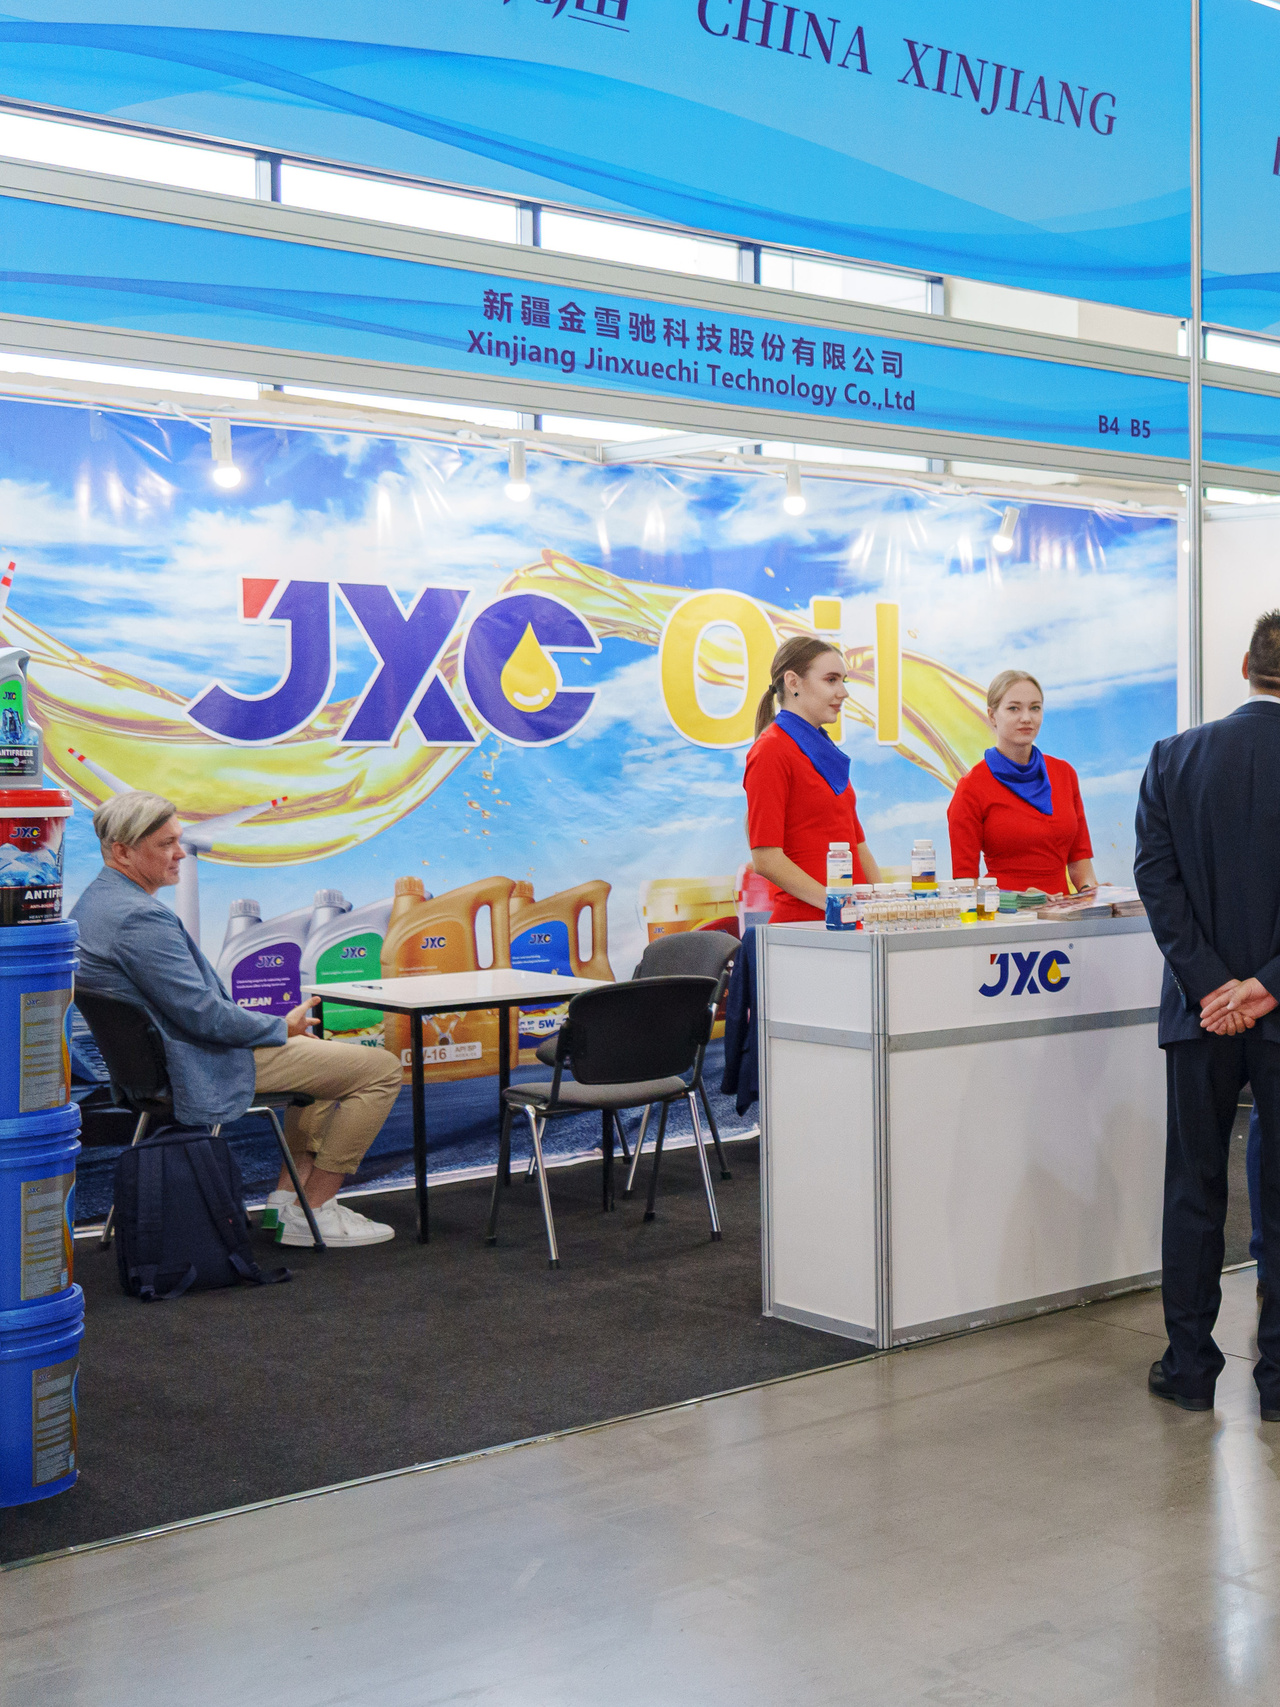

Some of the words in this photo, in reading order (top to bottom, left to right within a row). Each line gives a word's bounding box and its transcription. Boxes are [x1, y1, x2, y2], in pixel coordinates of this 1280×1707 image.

[697, 0, 873, 75] CHINA
[897, 37, 1118, 136] XINJIANG
[483, 289, 904, 379] 新疆金雪驰科技股份有限公司
[467, 329, 576, 373] Xinjiang
[584, 346, 699, 386] Jinxuechi
[707, 363, 837, 407] Technology
[844, 383, 916, 412] Co.,Ltd
[1098, 415, 1121, 436] B4
[1130, 419, 1151, 440] B5
[186, 577, 602, 748] JXC
[3, 691, 16, 700] JXC
[10, 827, 40, 838] JXC
[421, 936, 447, 950] JXC
[529, 933, 552, 944] JXC
[341, 947, 367, 959] JXC
[255, 955, 285, 968] JXC
[978, 950, 1071, 998] JXC
[237, 997, 272, 1007] CLEAN
[538, 1018, 567, 1029] 5W-
[405, 1047, 447, 1064] 0-16
